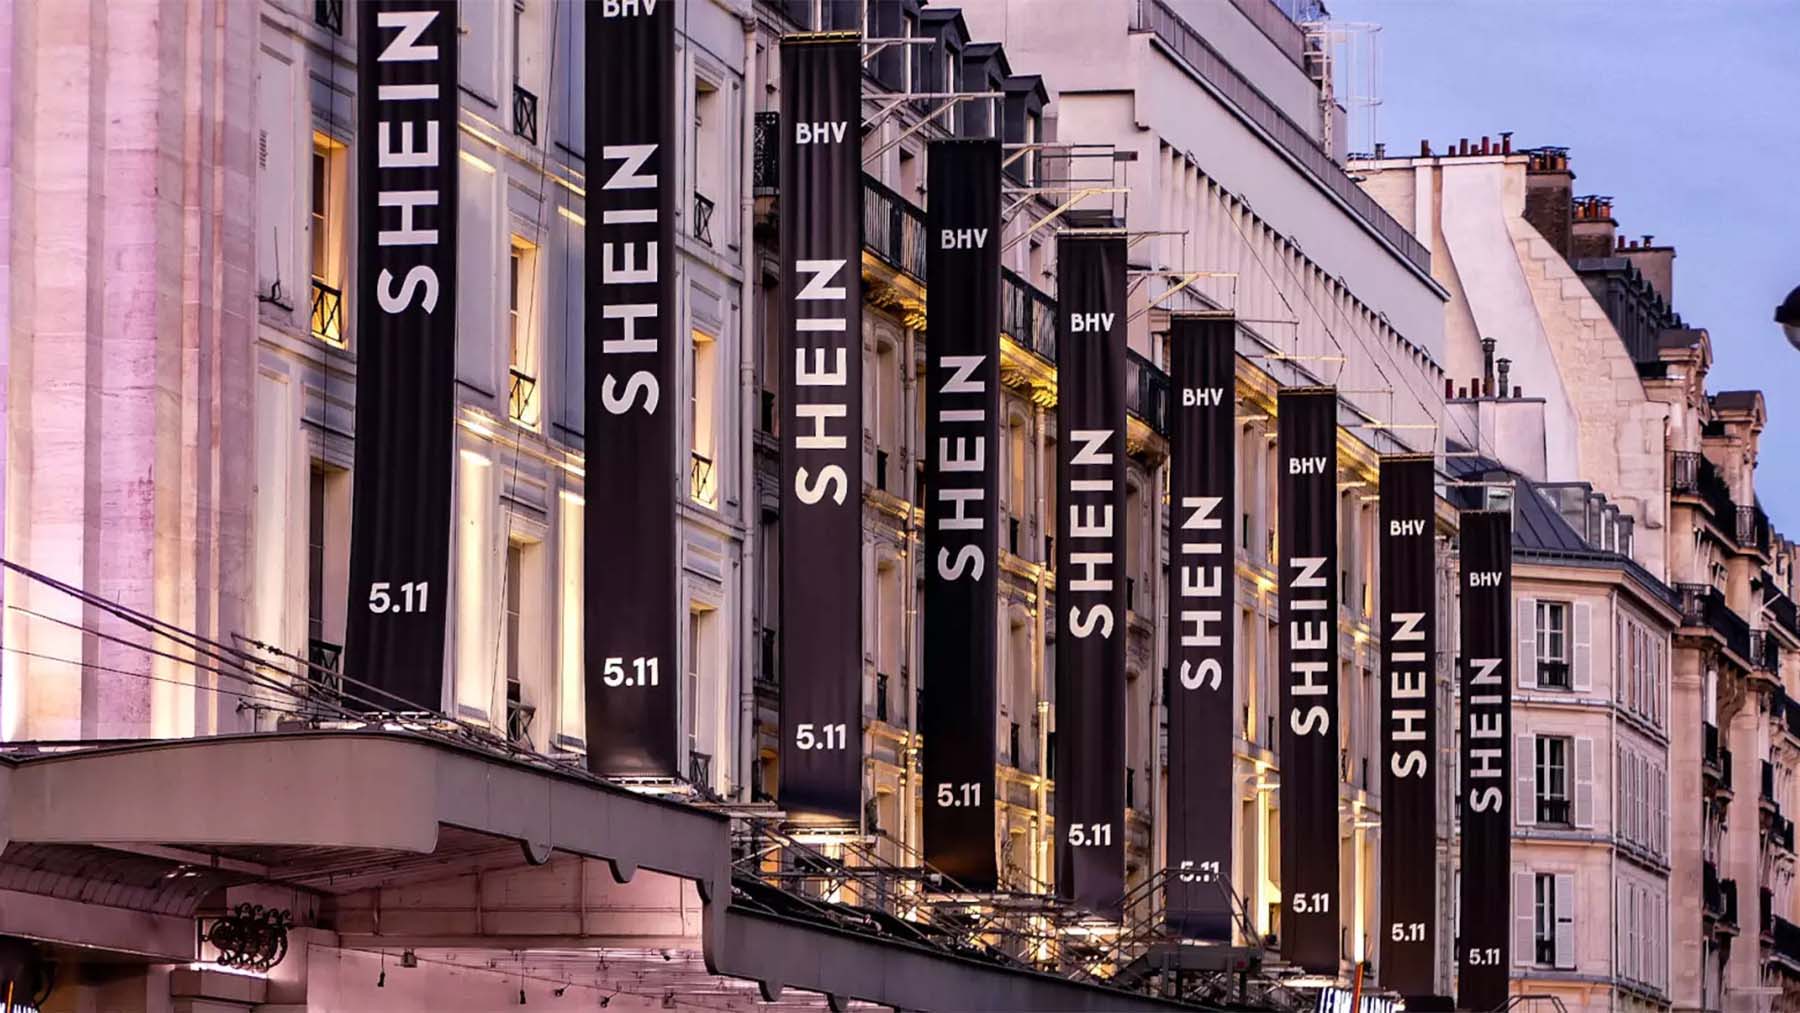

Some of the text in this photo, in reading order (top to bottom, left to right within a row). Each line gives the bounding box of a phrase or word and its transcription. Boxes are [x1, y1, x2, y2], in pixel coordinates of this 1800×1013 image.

[604, 0, 656, 17] BHV
[797, 122, 847, 143] BHV
[377, 11, 439, 313] SHEIN
[942, 229, 987, 248] BHV
[602, 144, 659, 414] SHEIN
[1072, 313, 1114, 332] BHV
[795, 260, 847, 505] SHEIN
[1183, 389, 1223, 406] BHV
[938, 356, 985, 581] SHEIN
[1290, 458, 1326, 474] BHV
[1070, 431, 1113, 638] SHEIN
[1391, 520, 1424, 535] BHV
[1470, 572, 1501, 586] BHV
[369, 582, 427, 613] 5.11
[1181, 497, 1222, 690] SHEIN
[1290, 558, 1329, 735] SHEIN
[604, 657, 658, 686] 5.11
[1391, 613, 1426, 777] SHEIN
[797, 724, 845, 749] 5.11
[1470, 659, 1502, 812] SHEIN
[938, 783, 980, 806] 5.11
[1069, 824, 1110, 845] 5.11
[1293, 893, 1328, 912] 5.11
[1392, 923, 1424, 941] 5.11
[1470, 949, 1499, 964] 5.11
